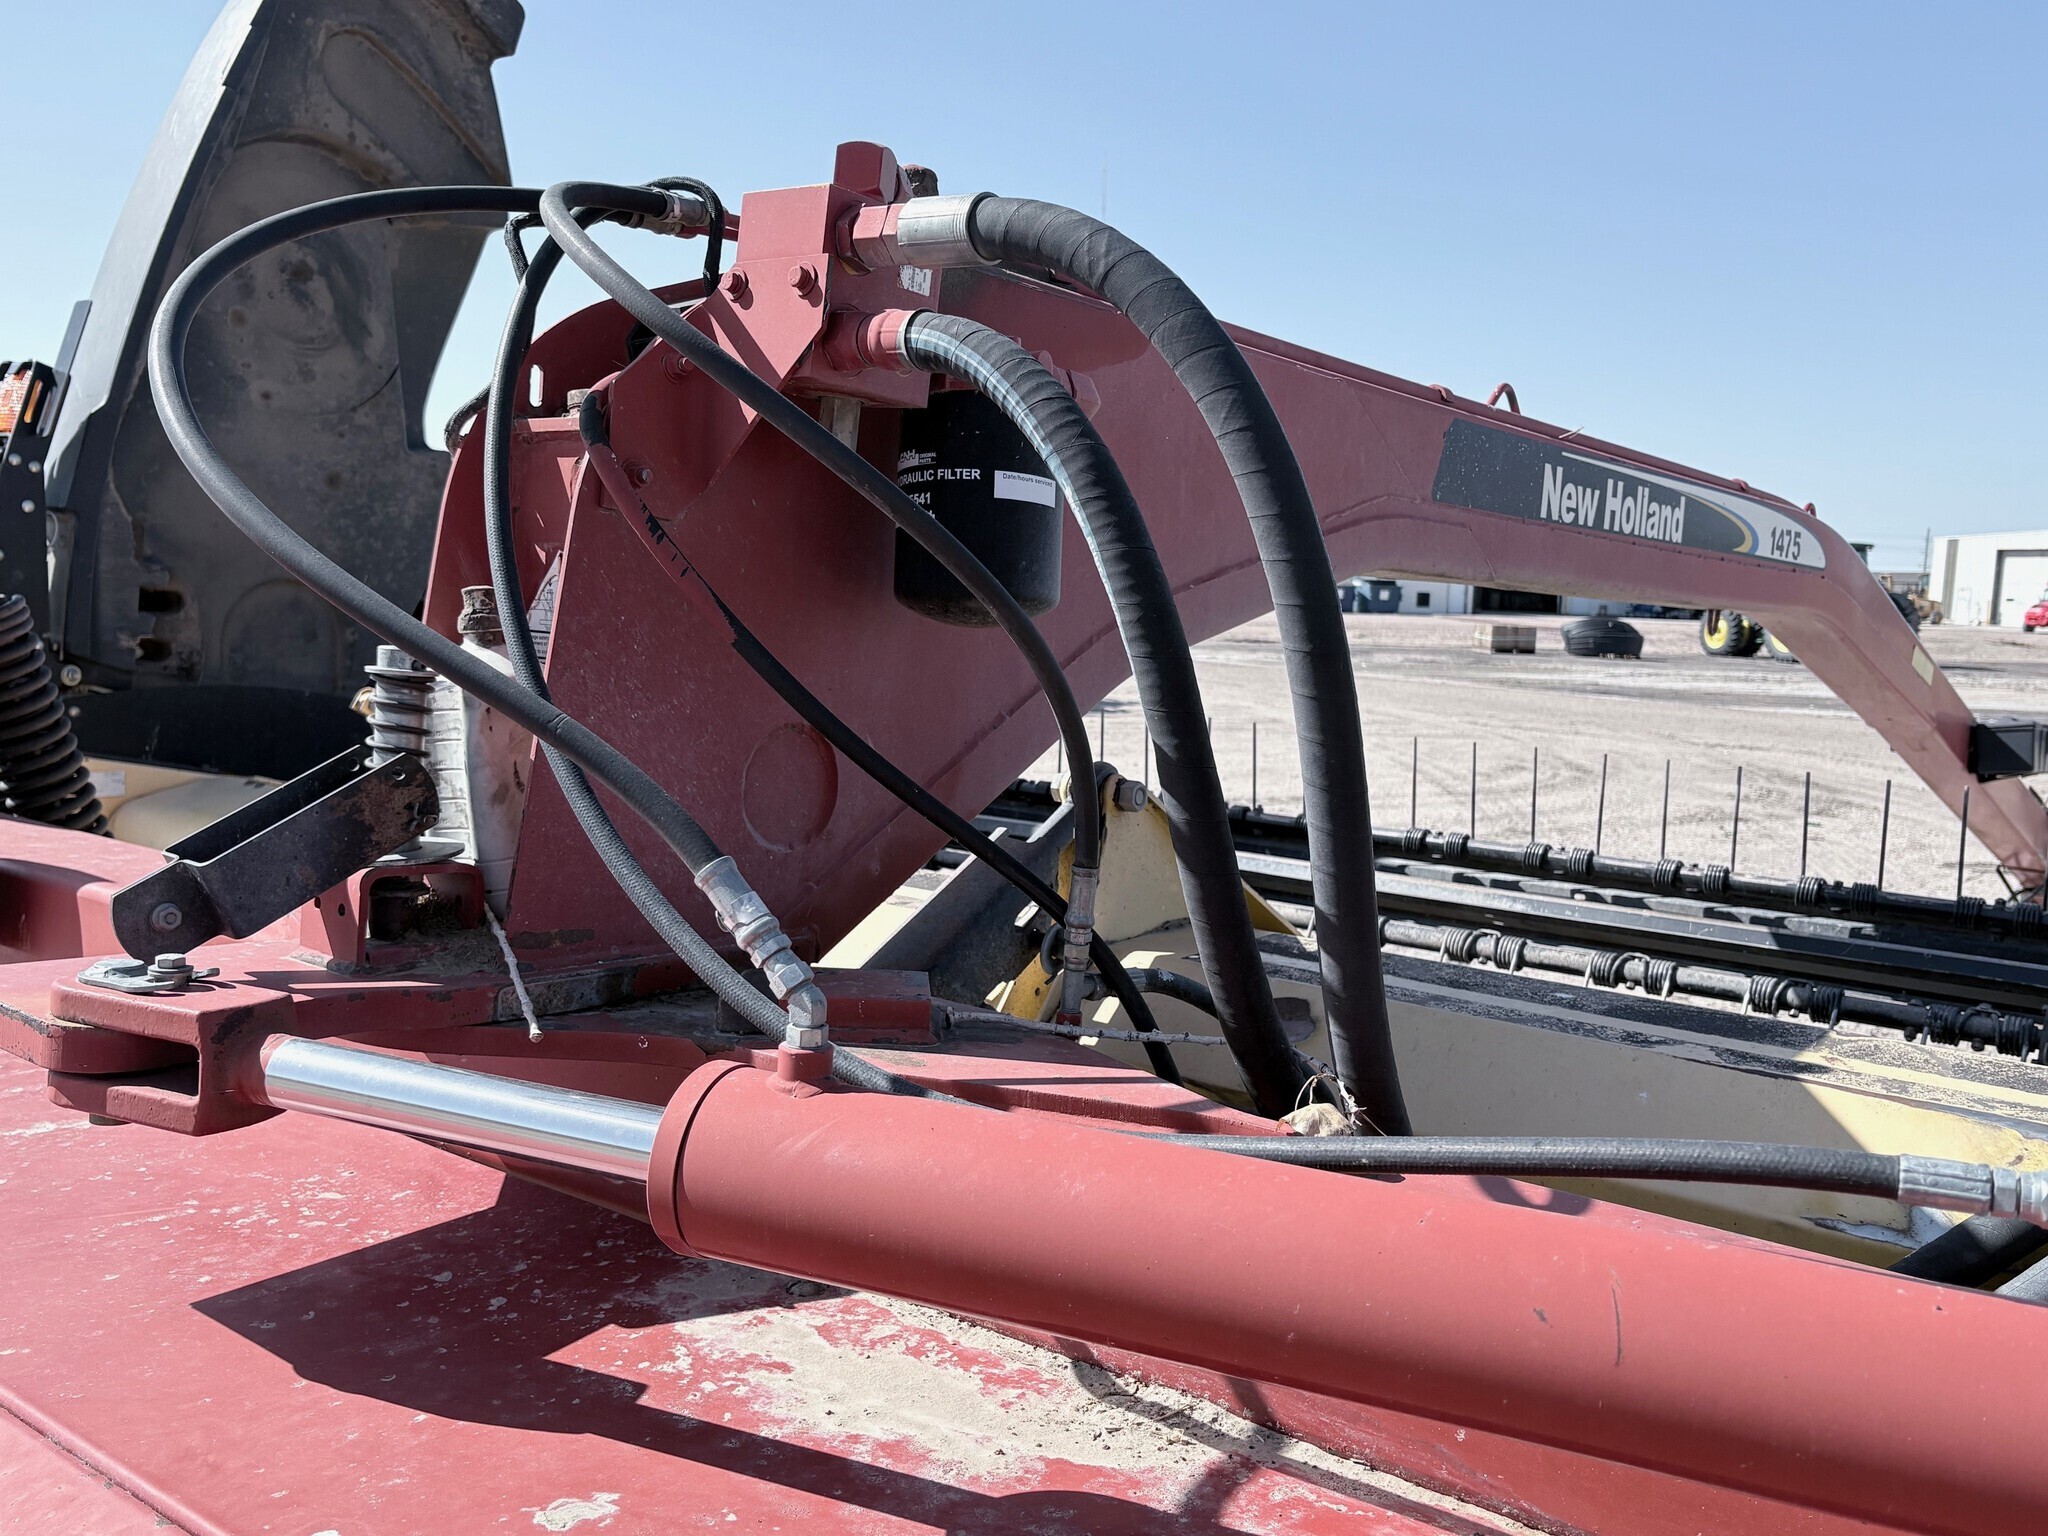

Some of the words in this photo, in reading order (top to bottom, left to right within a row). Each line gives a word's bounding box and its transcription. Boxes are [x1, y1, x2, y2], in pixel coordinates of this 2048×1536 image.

[900, 449, 916, 463] CNH
[937, 468, 981, 480] FILTER
[1002, 472, 1034, 483] Date/hours
[1540, 463, 1600, 527] New
[1603, 478, 1685, 544] Holland
[1770, 526, 1801, 561] 1475
